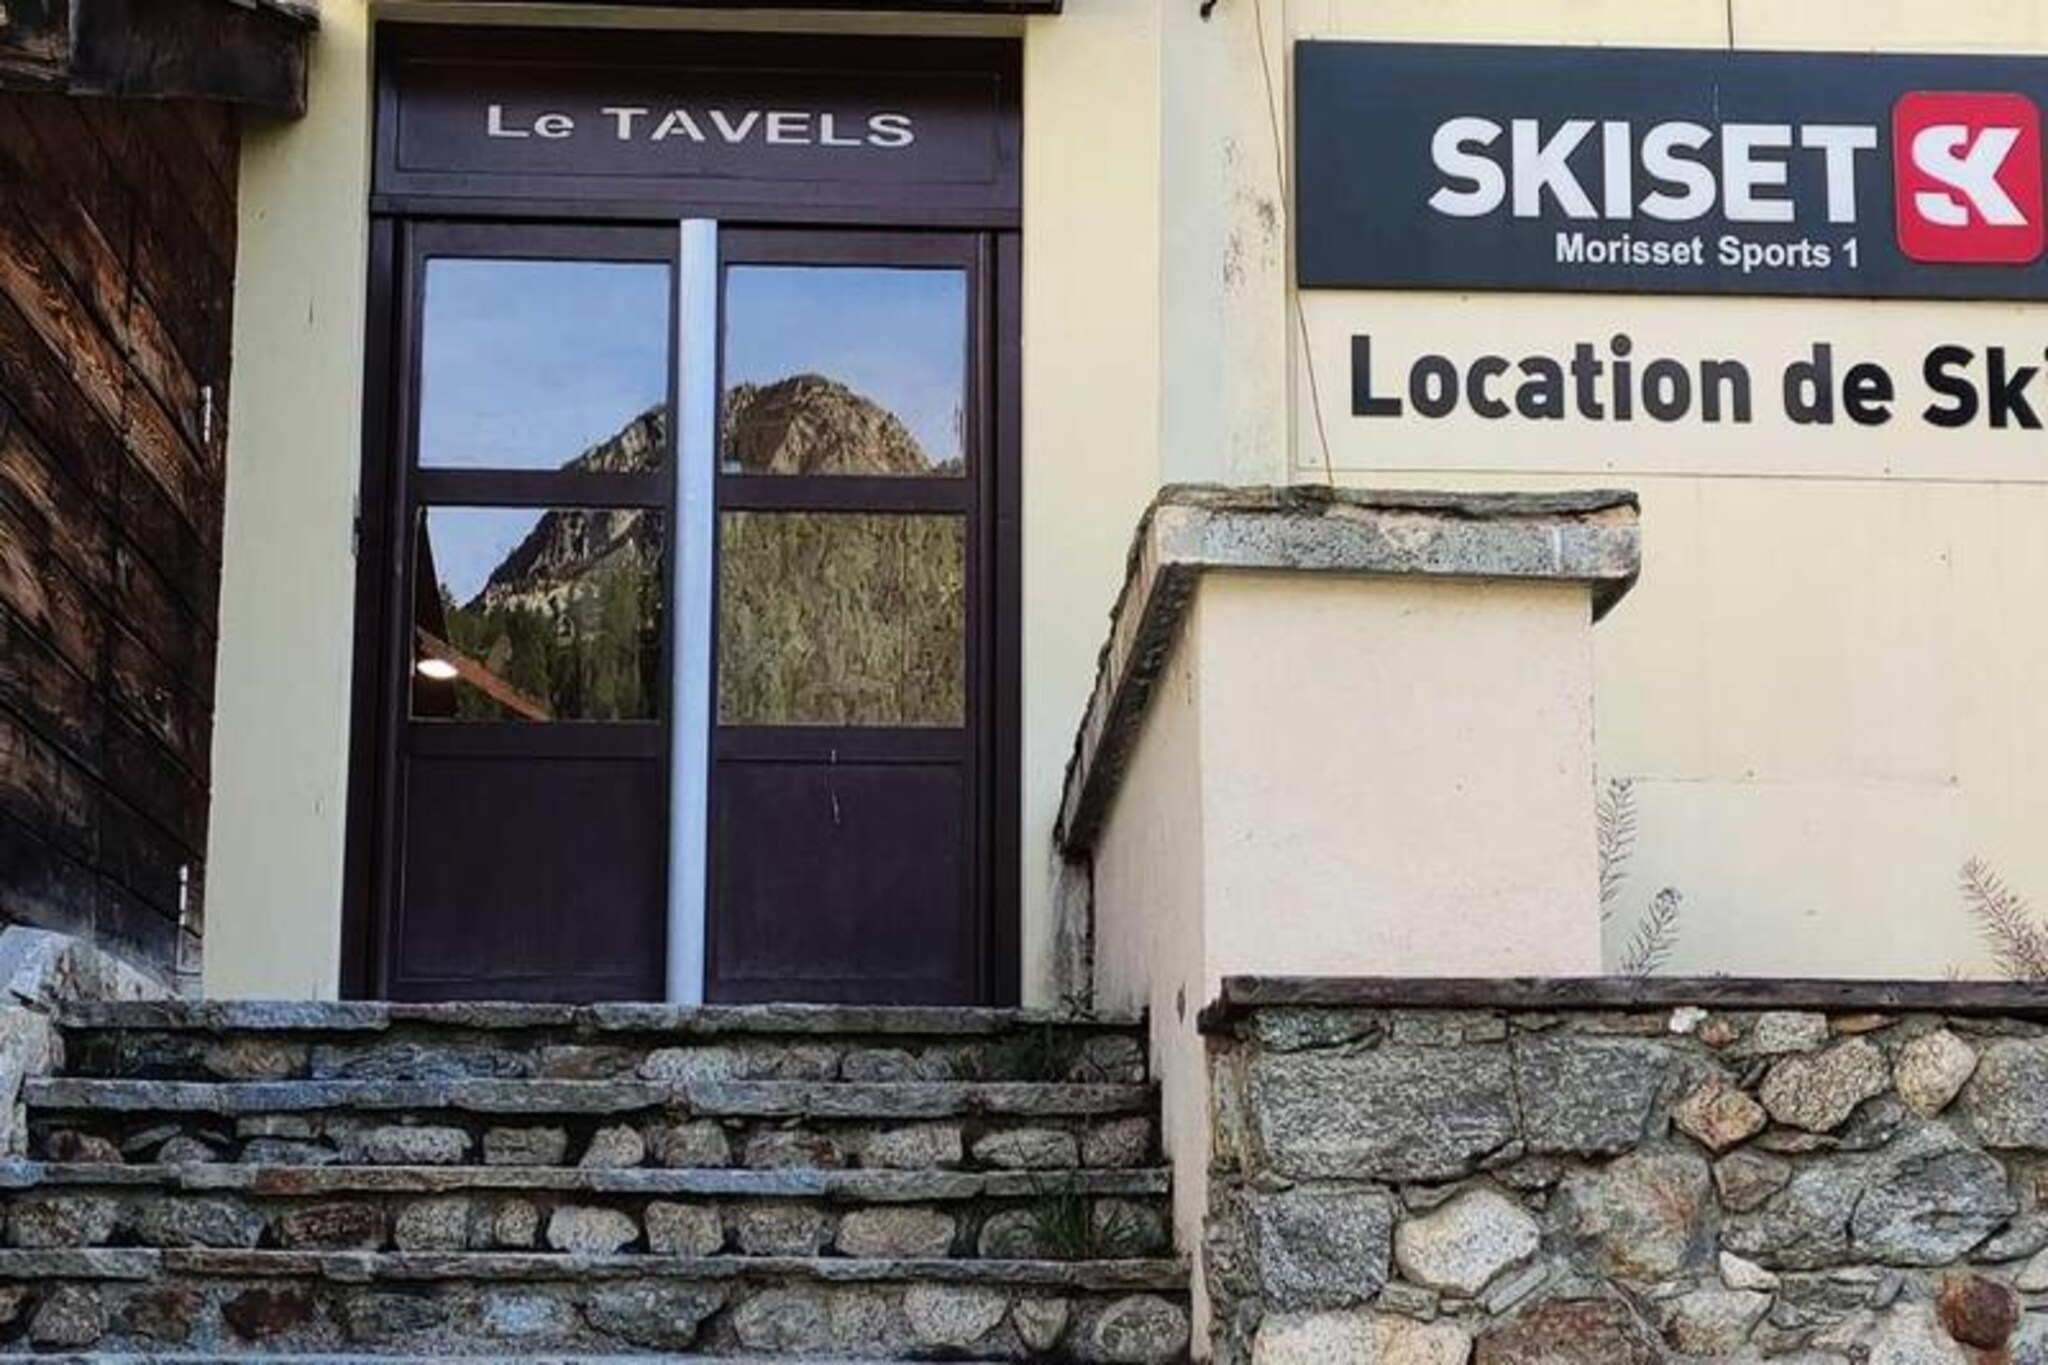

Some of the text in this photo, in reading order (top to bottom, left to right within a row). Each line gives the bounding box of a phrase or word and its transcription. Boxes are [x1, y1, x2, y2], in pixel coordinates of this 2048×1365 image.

[486, 105, 916, 147] Le TAVELS
[1427, 116, 1877, 223] SKISET
[1911, 124, 2029, 226] SK
[1555, 232, 1859, 273] Morisset Sports 1
[1350, 333, 2048, 430] Location de Sk
